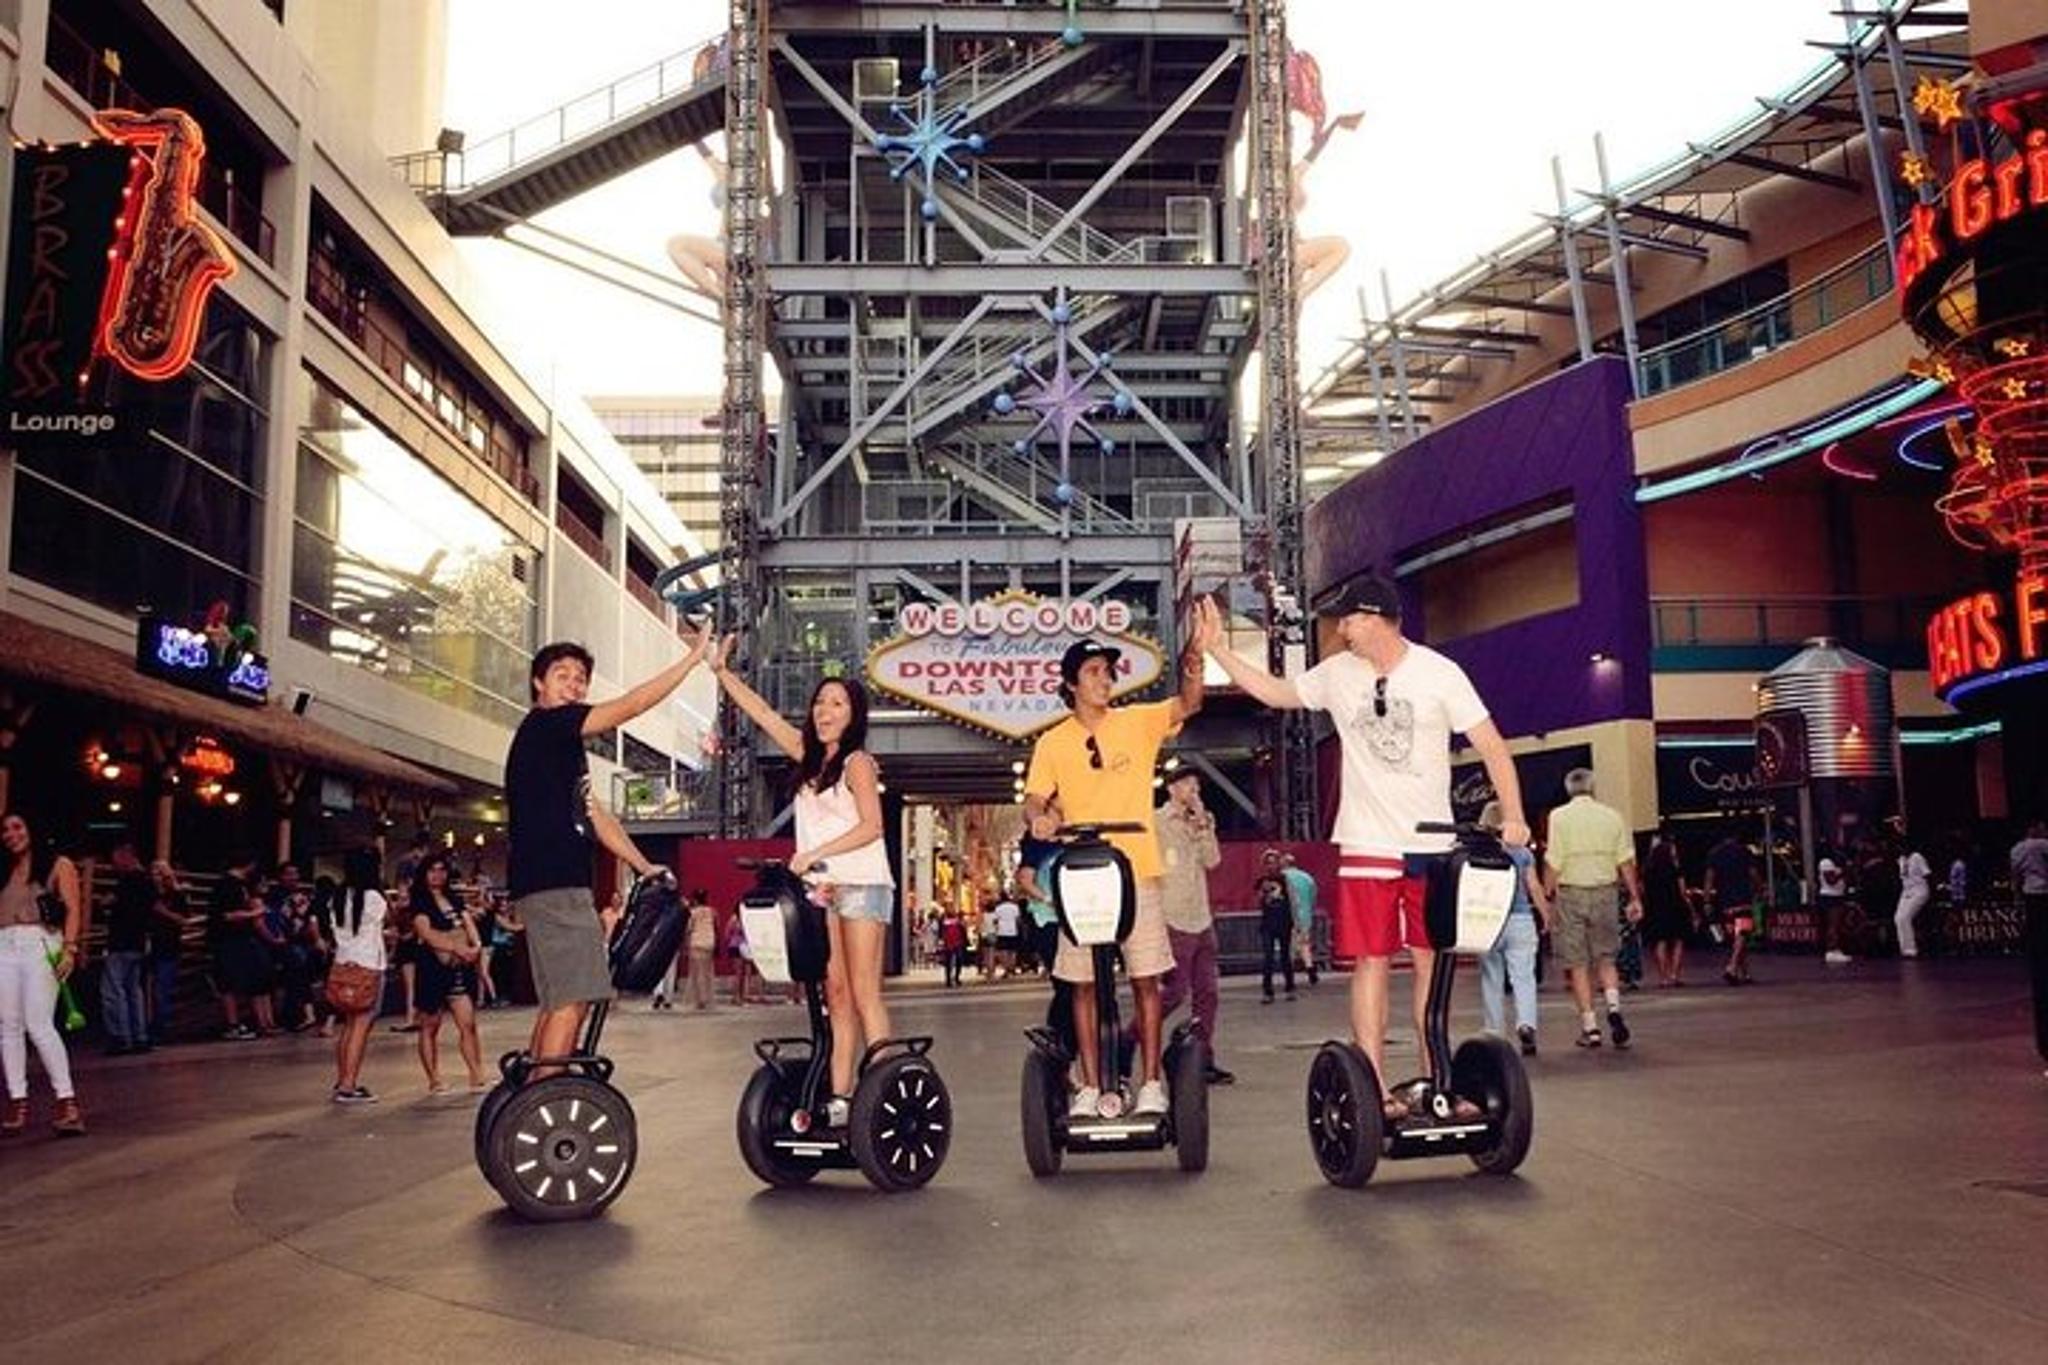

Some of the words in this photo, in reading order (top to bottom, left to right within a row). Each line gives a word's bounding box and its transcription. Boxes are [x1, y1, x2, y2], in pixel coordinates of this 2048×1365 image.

[10, 410, 116, 436] Lounge
[904, 606, 1123, 629] WELCOME
[930, 642, 953, 655] TO
[958, 634, 1069, 658] Fabulou
[901, 660, 1132, 678] DOWNTON
[928, 679, 985, 695] LAS
[998, 679, 1059, 695] VEG
[969, 700, 1065, 712] NEVADA
